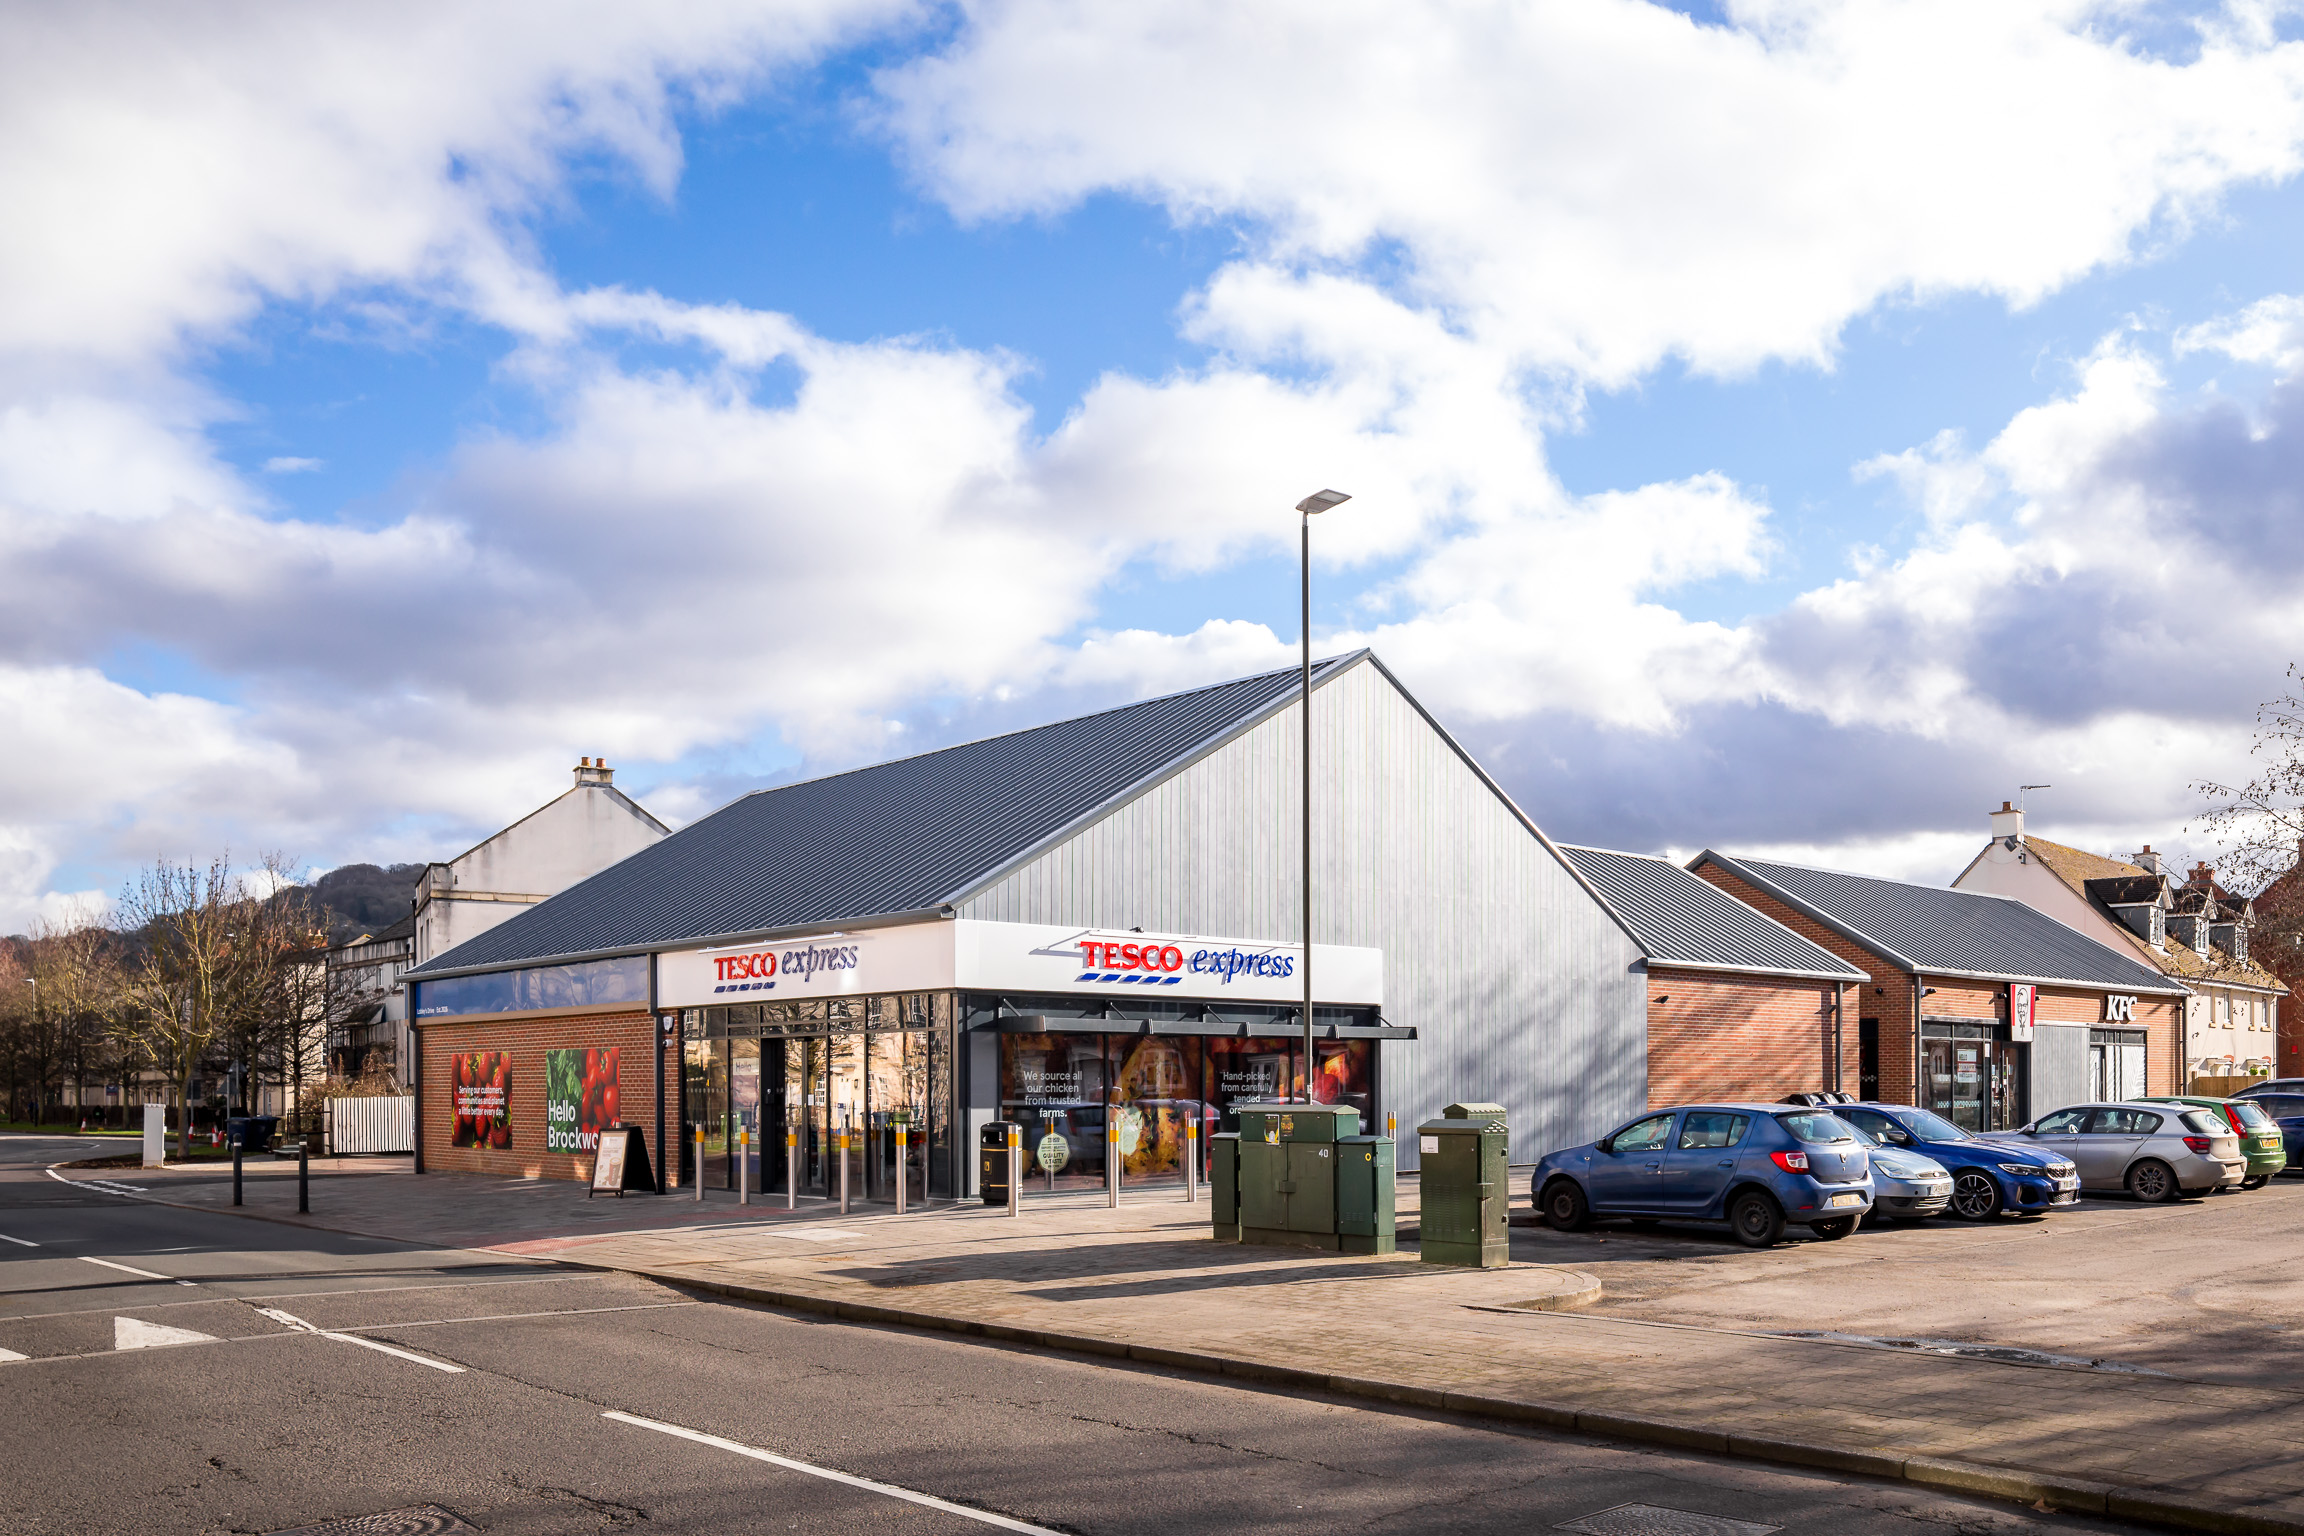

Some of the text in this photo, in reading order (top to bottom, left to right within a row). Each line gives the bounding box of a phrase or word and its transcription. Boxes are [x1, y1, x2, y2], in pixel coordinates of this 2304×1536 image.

[714, 944, 858, 982] TESCO express
[1080, 941, 1294, 983] TESCO express
[2106, 995, 2137, 1021] KFC
[1023, 1071, 1037, 1080] We
[1072, 1071, 1082, 1080] all
[1223, 1071, 1270, 1082] Hand-picked
[459, 1086, 473, 1096] Serving
[481, 1087, 503, 1095] customers,
[1045, 1083, 1079, 1092] chicken
[1221, 1083, 1272, 1093] from carefully
[458, 1097, 482, 1105] communities
[490, 1097, 504, 1108] planet
[1025, 1095, 1080, 1105] from trusted
[1234, 1094, 1260, 1102] tended
[462, 1106, 470, 1115] little
[471, 1107, 483, 1115] better
[484, 1108, 495, 1118] every
[496, 1107, 504, 1118] day.
[548, 1099, 576, 1122] Hello
[1039, 1107, 1068, 1117] farms.
[1318, 1149, 1329, 1158] 40
